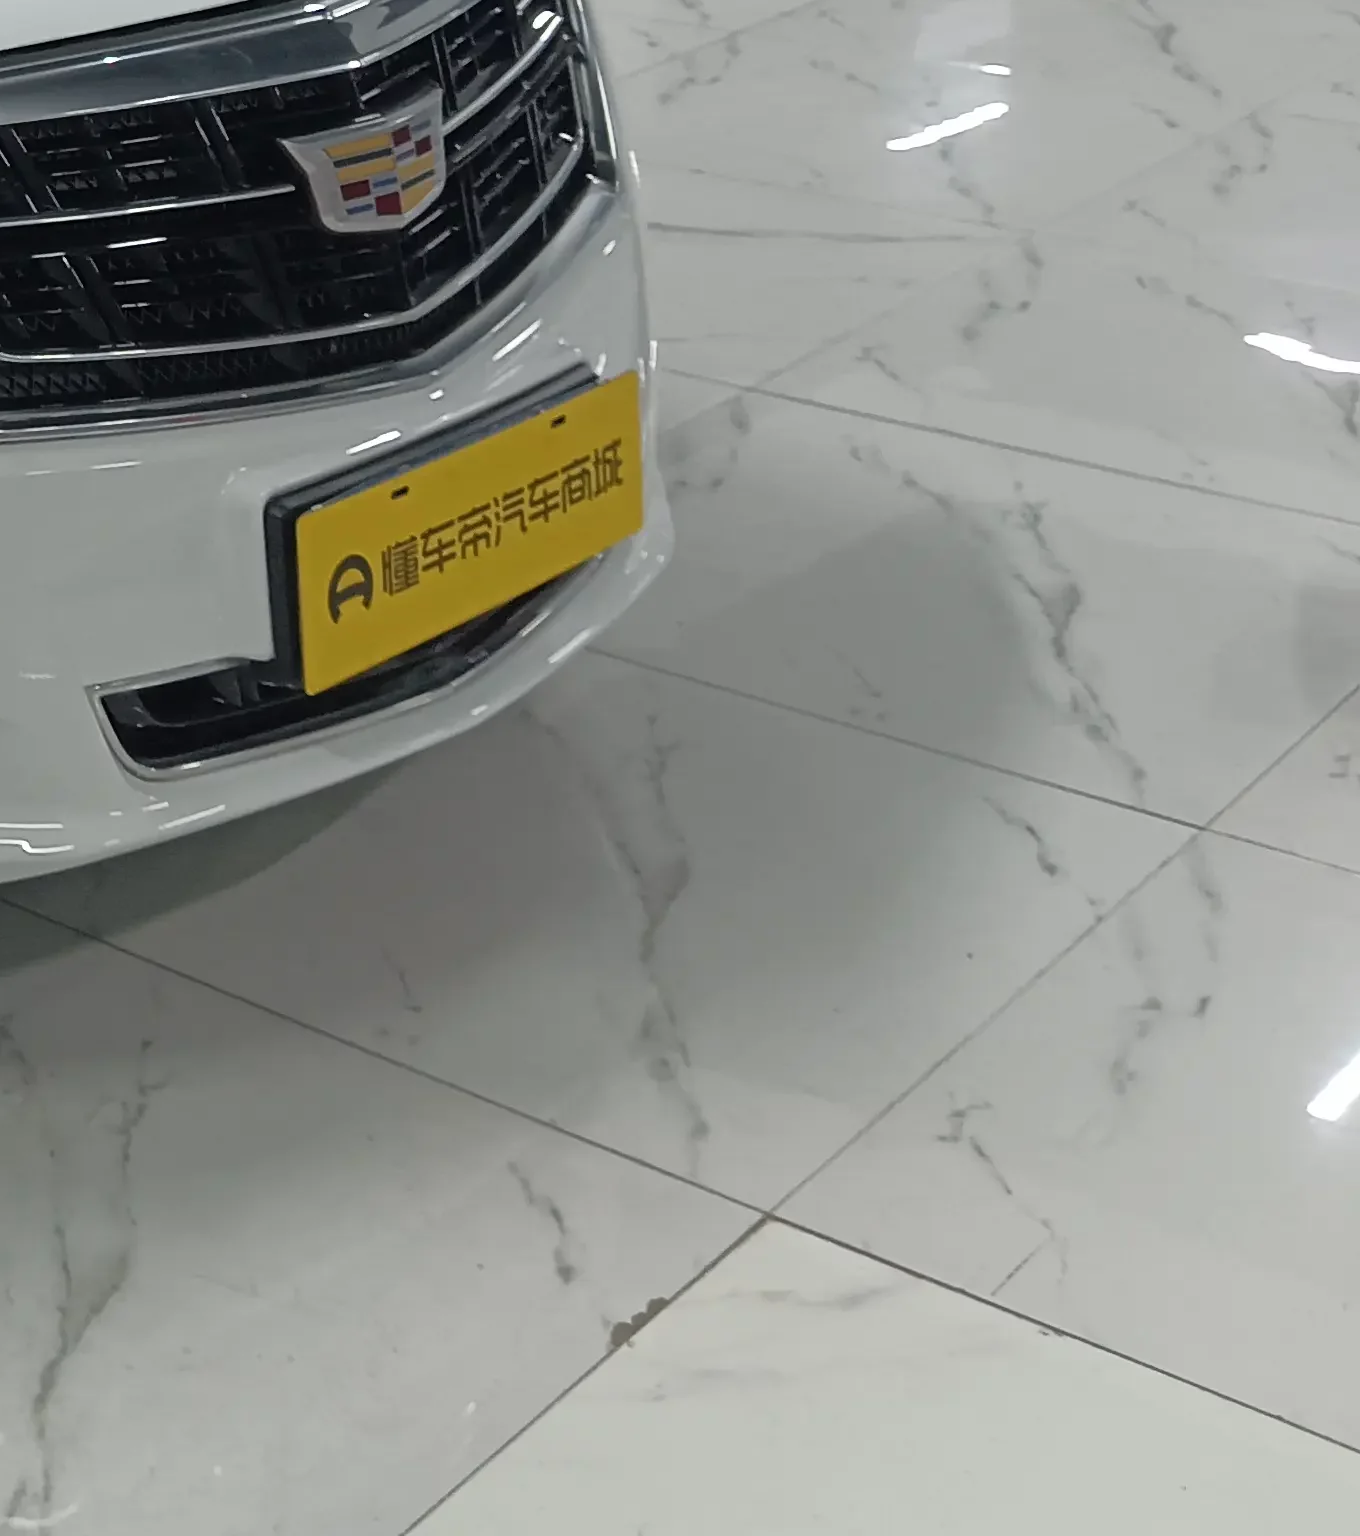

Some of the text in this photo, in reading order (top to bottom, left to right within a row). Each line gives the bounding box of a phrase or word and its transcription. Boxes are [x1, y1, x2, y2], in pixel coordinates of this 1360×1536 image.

[381, 437, 624, 597] 懂车帝汽车商城
